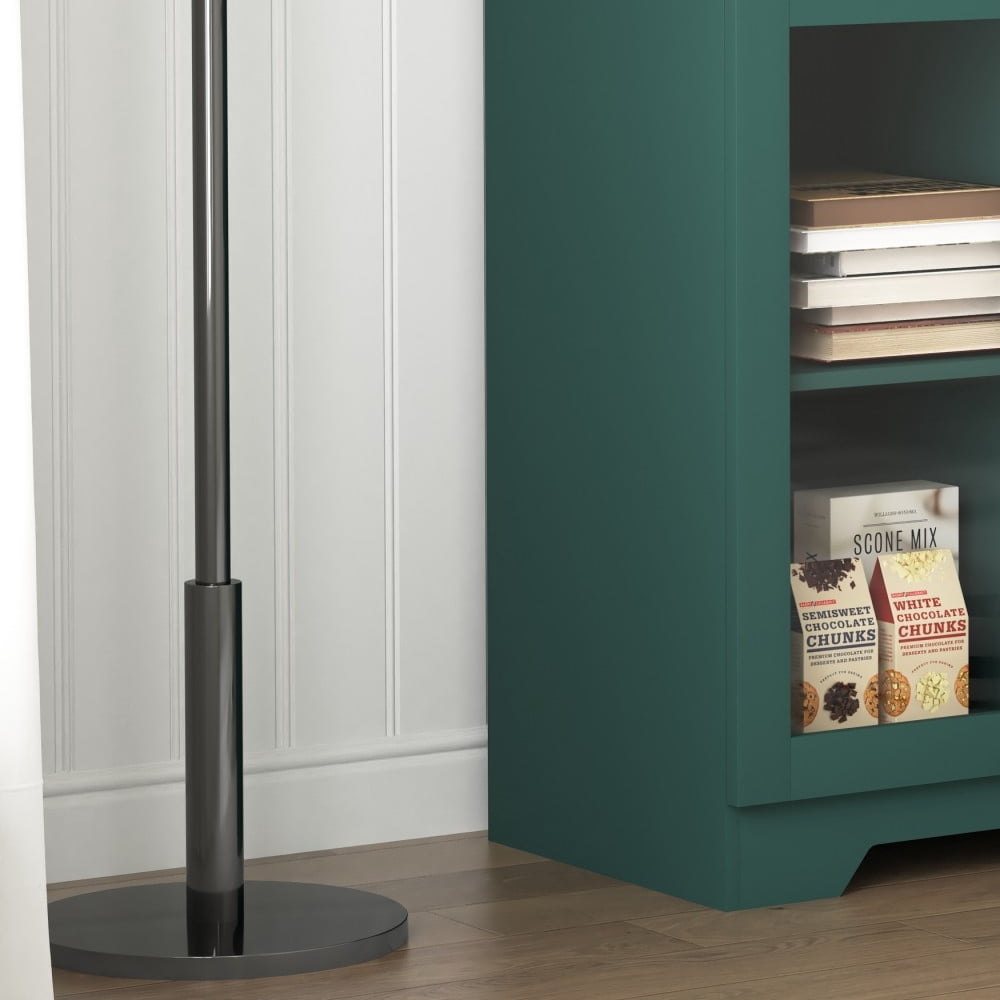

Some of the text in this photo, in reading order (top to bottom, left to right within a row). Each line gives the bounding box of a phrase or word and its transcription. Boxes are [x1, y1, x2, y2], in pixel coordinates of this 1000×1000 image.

[853, 527, 938, 556] SCONE MIX
[893, 597, 941, 611] WHITE
[802, 606, 871, 621] SEMISWEET
[897, 607, 965, 622] CHOCOLATE
[805, 617, 875, 632] CHOCOLATE
[898, 619, 966, 637] CHUNKS
[806, 629, 876, 647] CHUNKS
